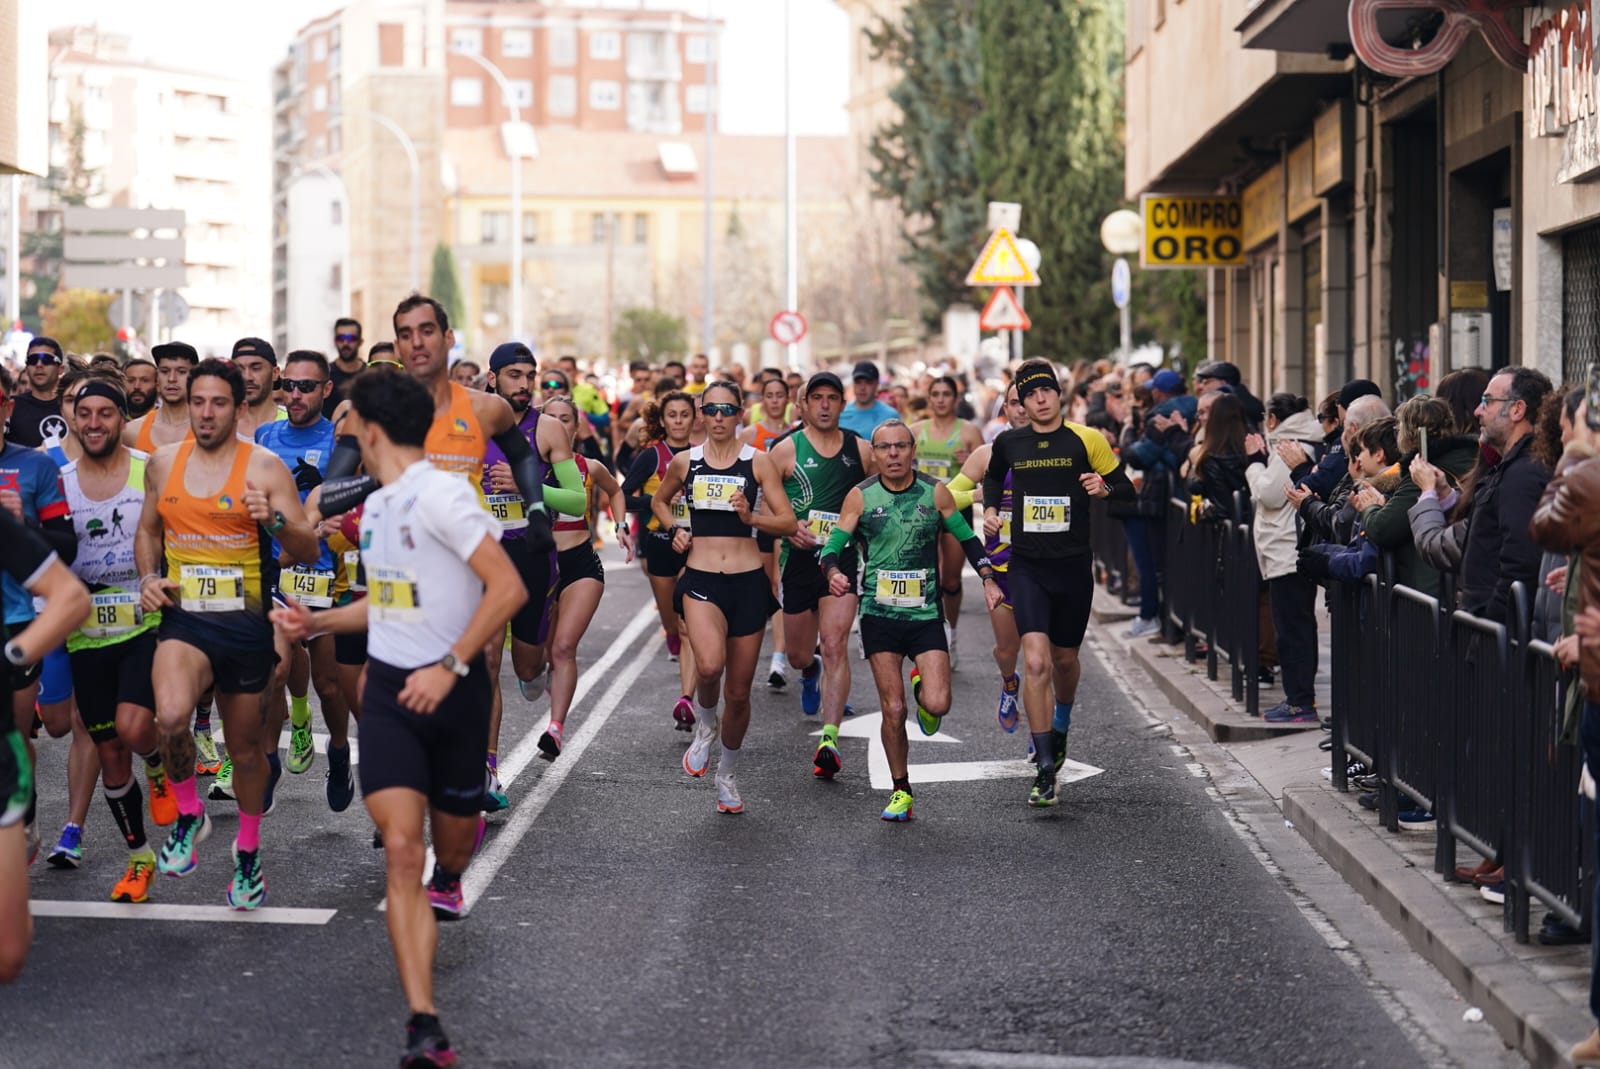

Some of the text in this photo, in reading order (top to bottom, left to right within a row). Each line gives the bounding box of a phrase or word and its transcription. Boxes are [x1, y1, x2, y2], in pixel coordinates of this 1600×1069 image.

[1152, 202, 1242, 229] COMPRO
[1152, 235, 1241, 260] ORO
[1026, 457, 1073, 468] RUNNERS
[706, 483, 723, 497] 53
[488, 495, 522, 504] SETEL
[491, 503, 508, 518] 56
[1032, 505, 1055, 520] 204
[195, 567, 237, 576] SETEL
[889, 571, 922, 579] SETEL
[198, 577, 217, 596] 79
[293, 575, 316, 593] 149
[891, 580, 907, 595] 70
[94, 595, 136, 605] SETEL
[97, 605, 117, 624] 68
